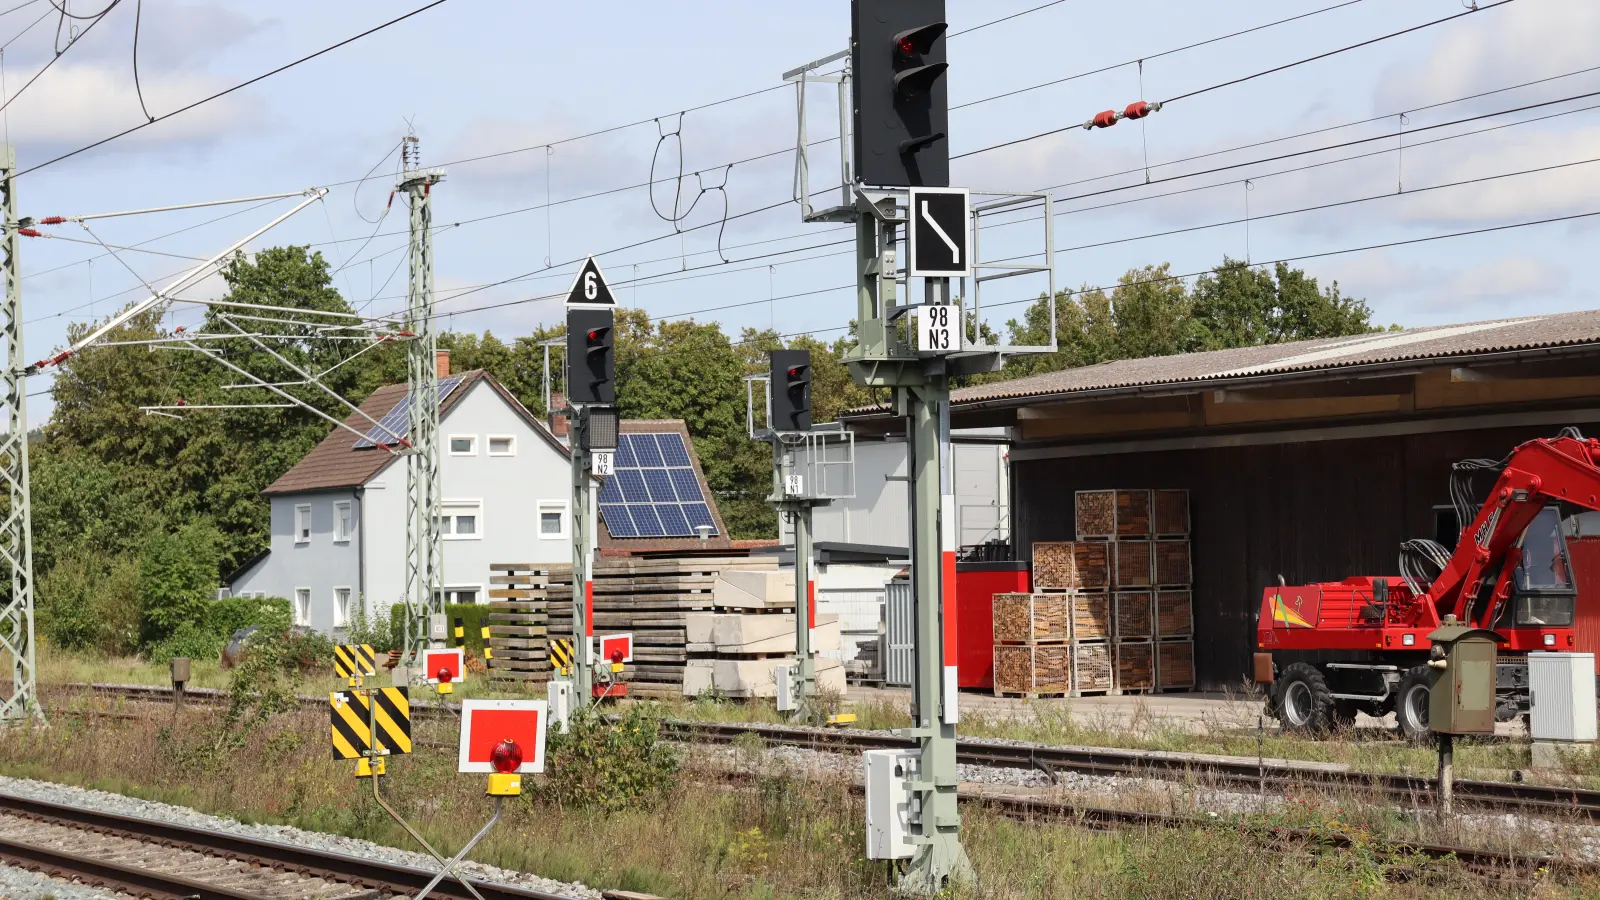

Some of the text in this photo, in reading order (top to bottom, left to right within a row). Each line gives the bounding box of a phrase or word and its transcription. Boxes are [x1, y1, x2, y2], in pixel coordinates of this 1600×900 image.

[584, 271, 597, 300] 6
[929, 307, 948, 327] 98
[929, 329, 949, 349] N3
[597, 454, 608, 464] 98
[597, 465, 608, 474] N2
[790, 475, 798, 484] 98
[790, 485, 798, 493] N1
